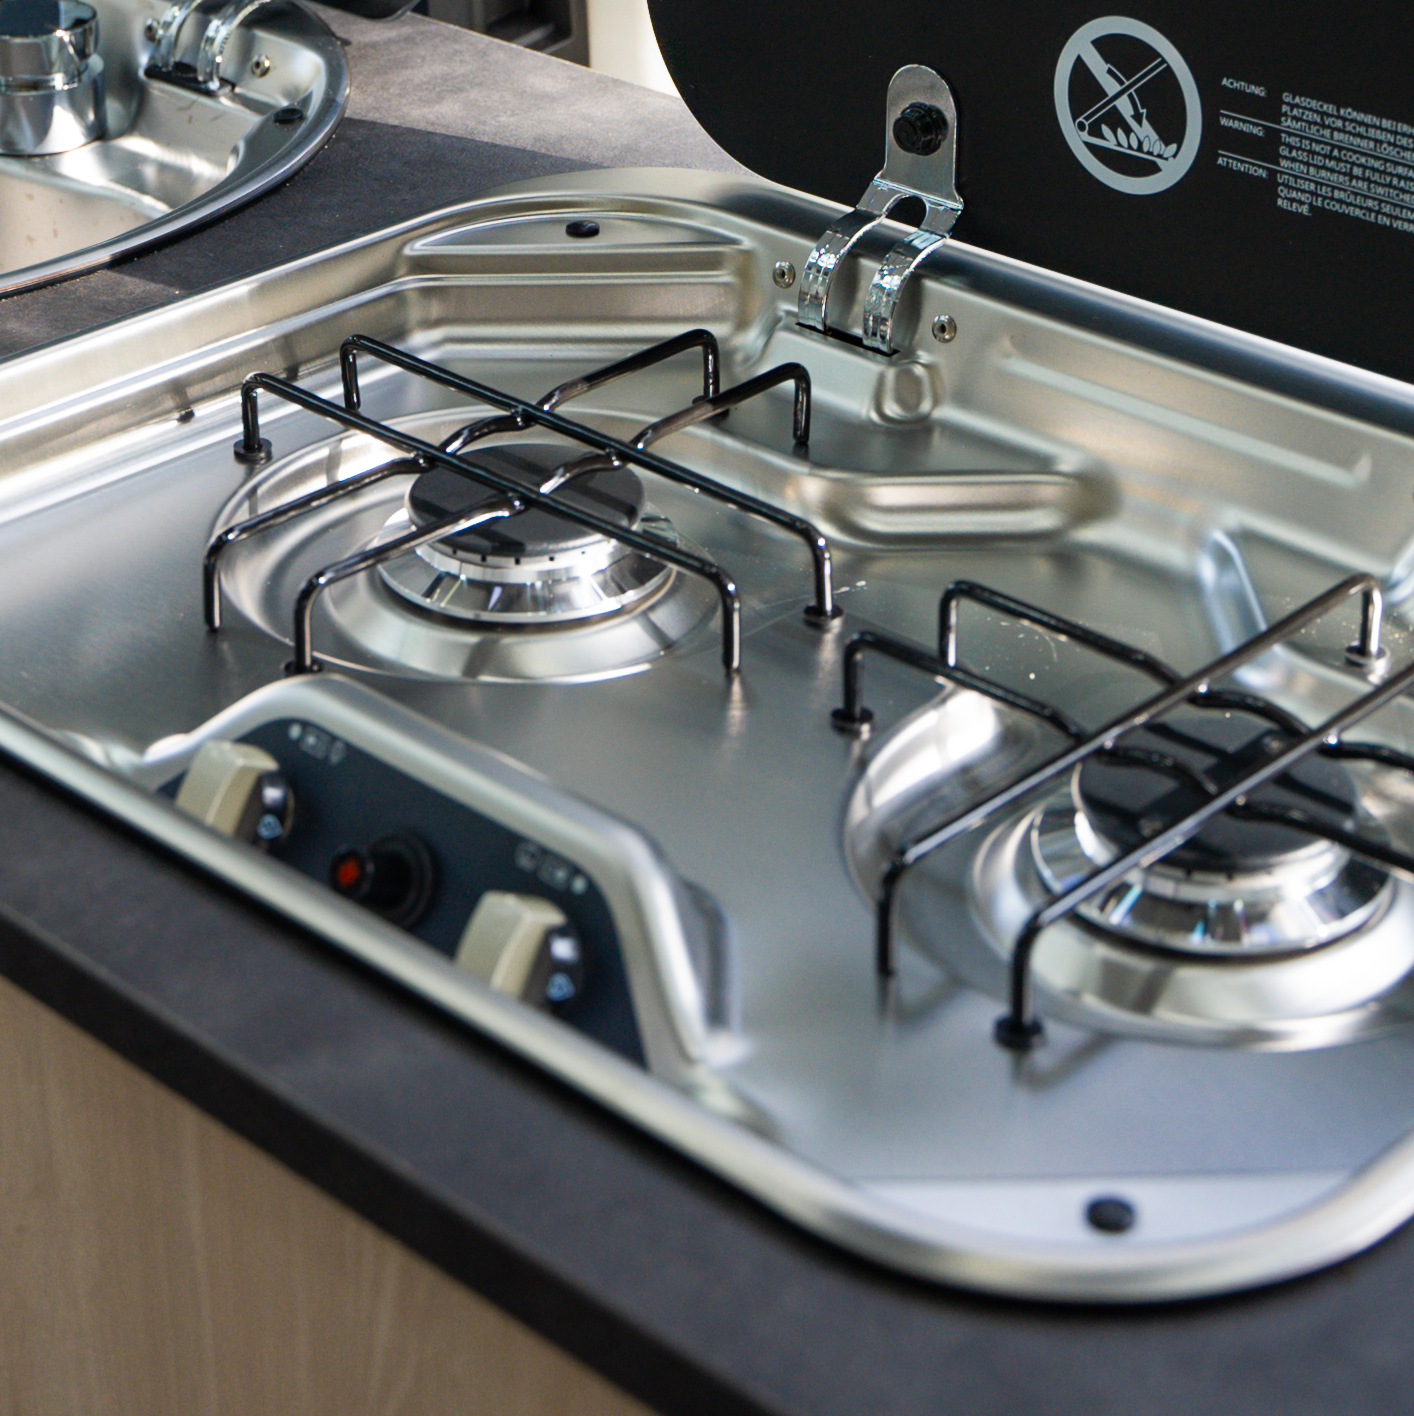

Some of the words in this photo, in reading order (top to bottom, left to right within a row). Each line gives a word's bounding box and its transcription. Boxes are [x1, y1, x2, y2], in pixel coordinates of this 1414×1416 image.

[1221, 77, 1266, 96] ACHTUNG:
[1219, 116, 1264, 136] WARNING:
[1278, 145, 1308, 161] GLASS
[1308, 153, 1324, 166] LID
[1324, 158, 1351, 173] MUST
[1351, 165, 1363, 177] BE
[1364, 168, 1391, 184] FULLY
[1280, 132, 1300, 147] THIS
[1301, 138, 1310, 150] IS
[1311, 141, 1331, 154] NOT
[1331, 148, 1339, 157] A
[1339, 150, 1385, 170] COOKING
[1216, 156, 1268, 178] ATTENTION:
[1276, 173, 1315, 192] UTILISER
[1316, 184, 1332, 197] LES
[1333, 188, 1379, 210] BRÛLEURS
